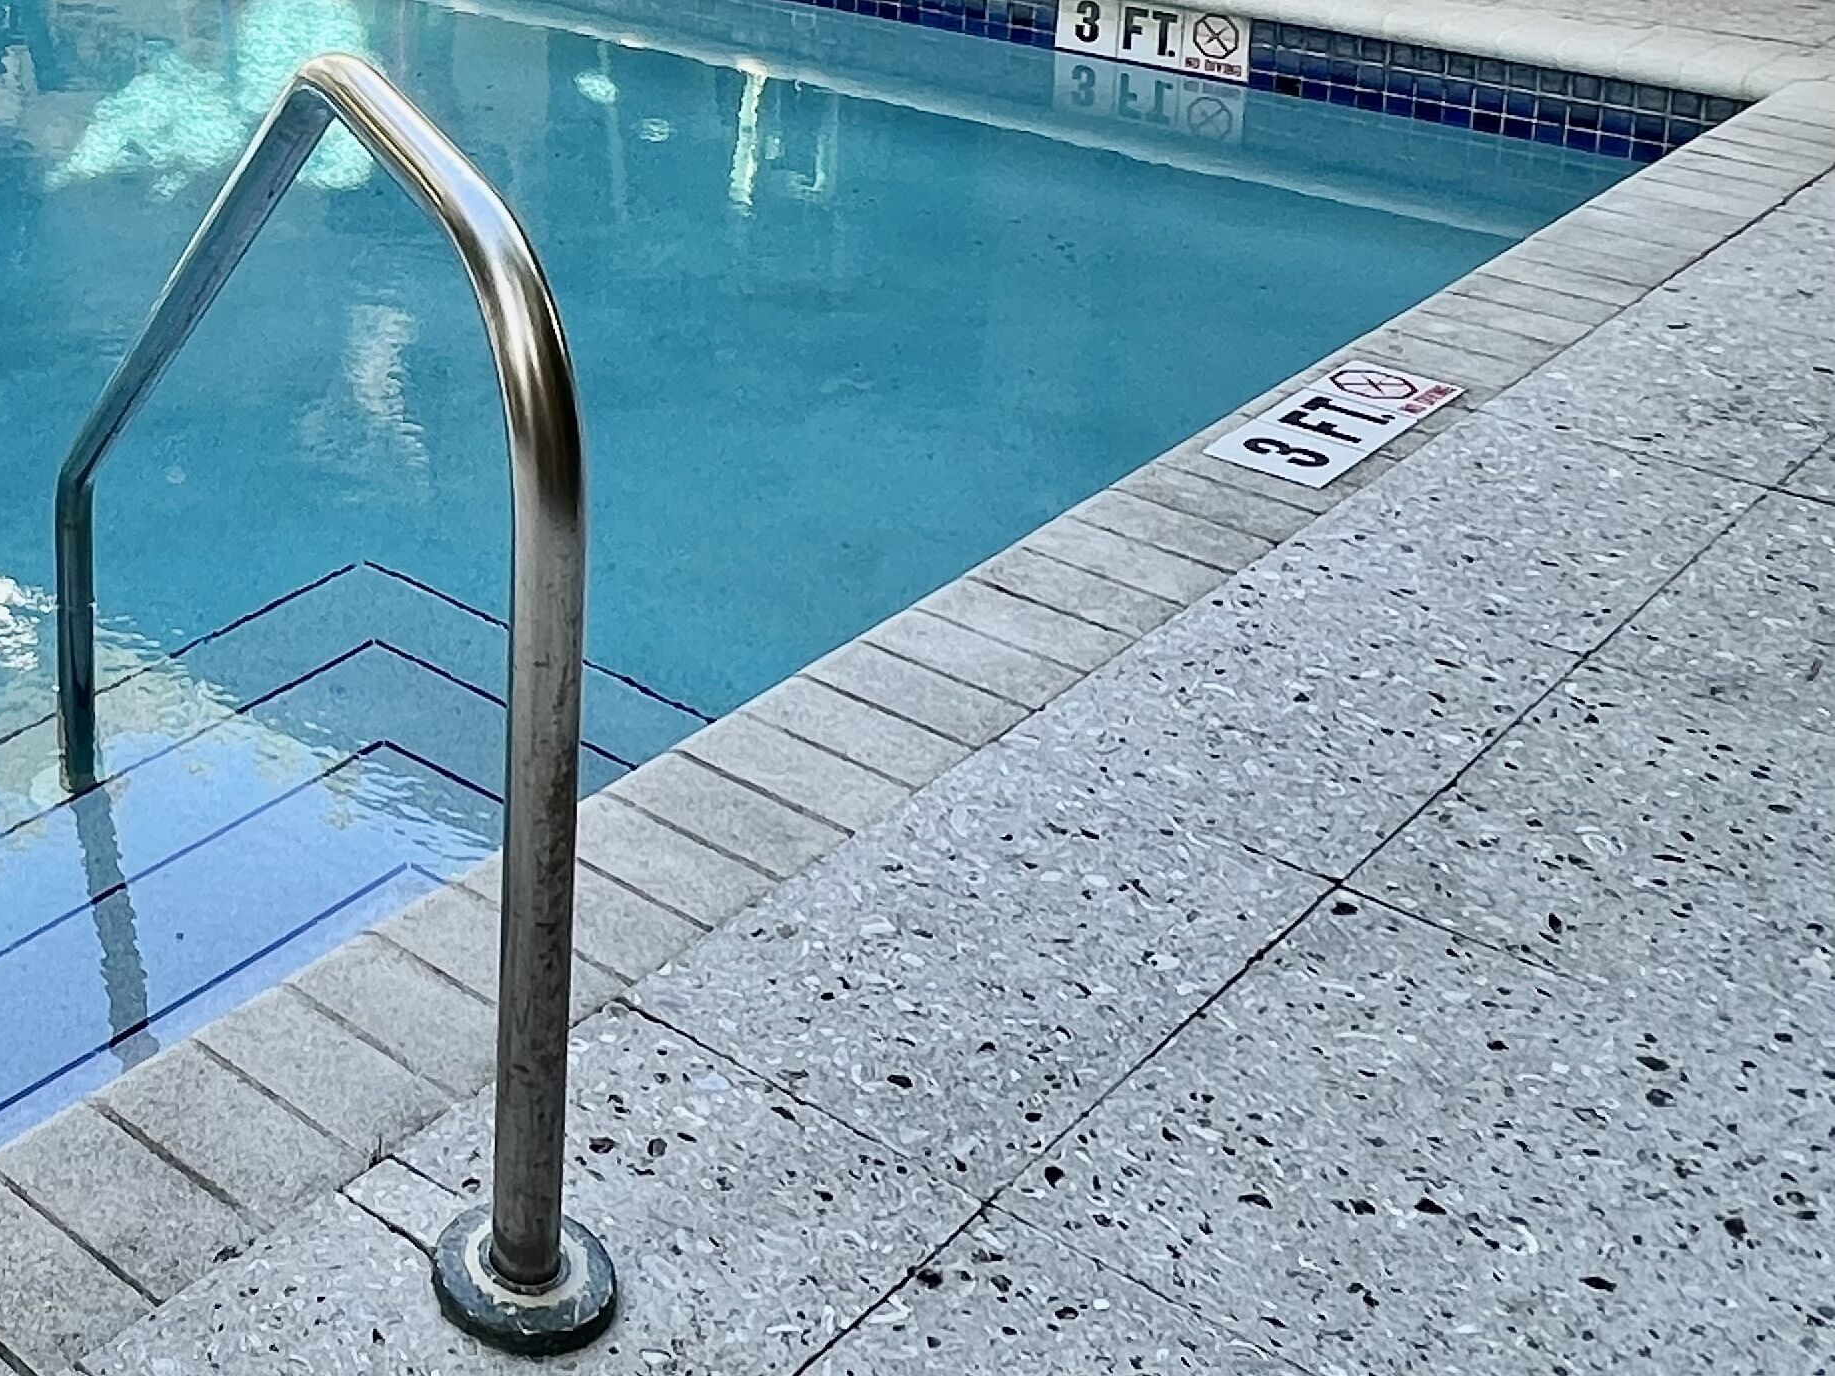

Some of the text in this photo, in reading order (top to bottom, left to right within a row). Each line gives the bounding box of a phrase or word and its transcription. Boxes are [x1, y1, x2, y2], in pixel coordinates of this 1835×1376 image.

[1074, 0, 1178, 58] 3 FT.
[1278, 396, 1396, 444] FT.
[1243, 437, 1330, 467] 3
